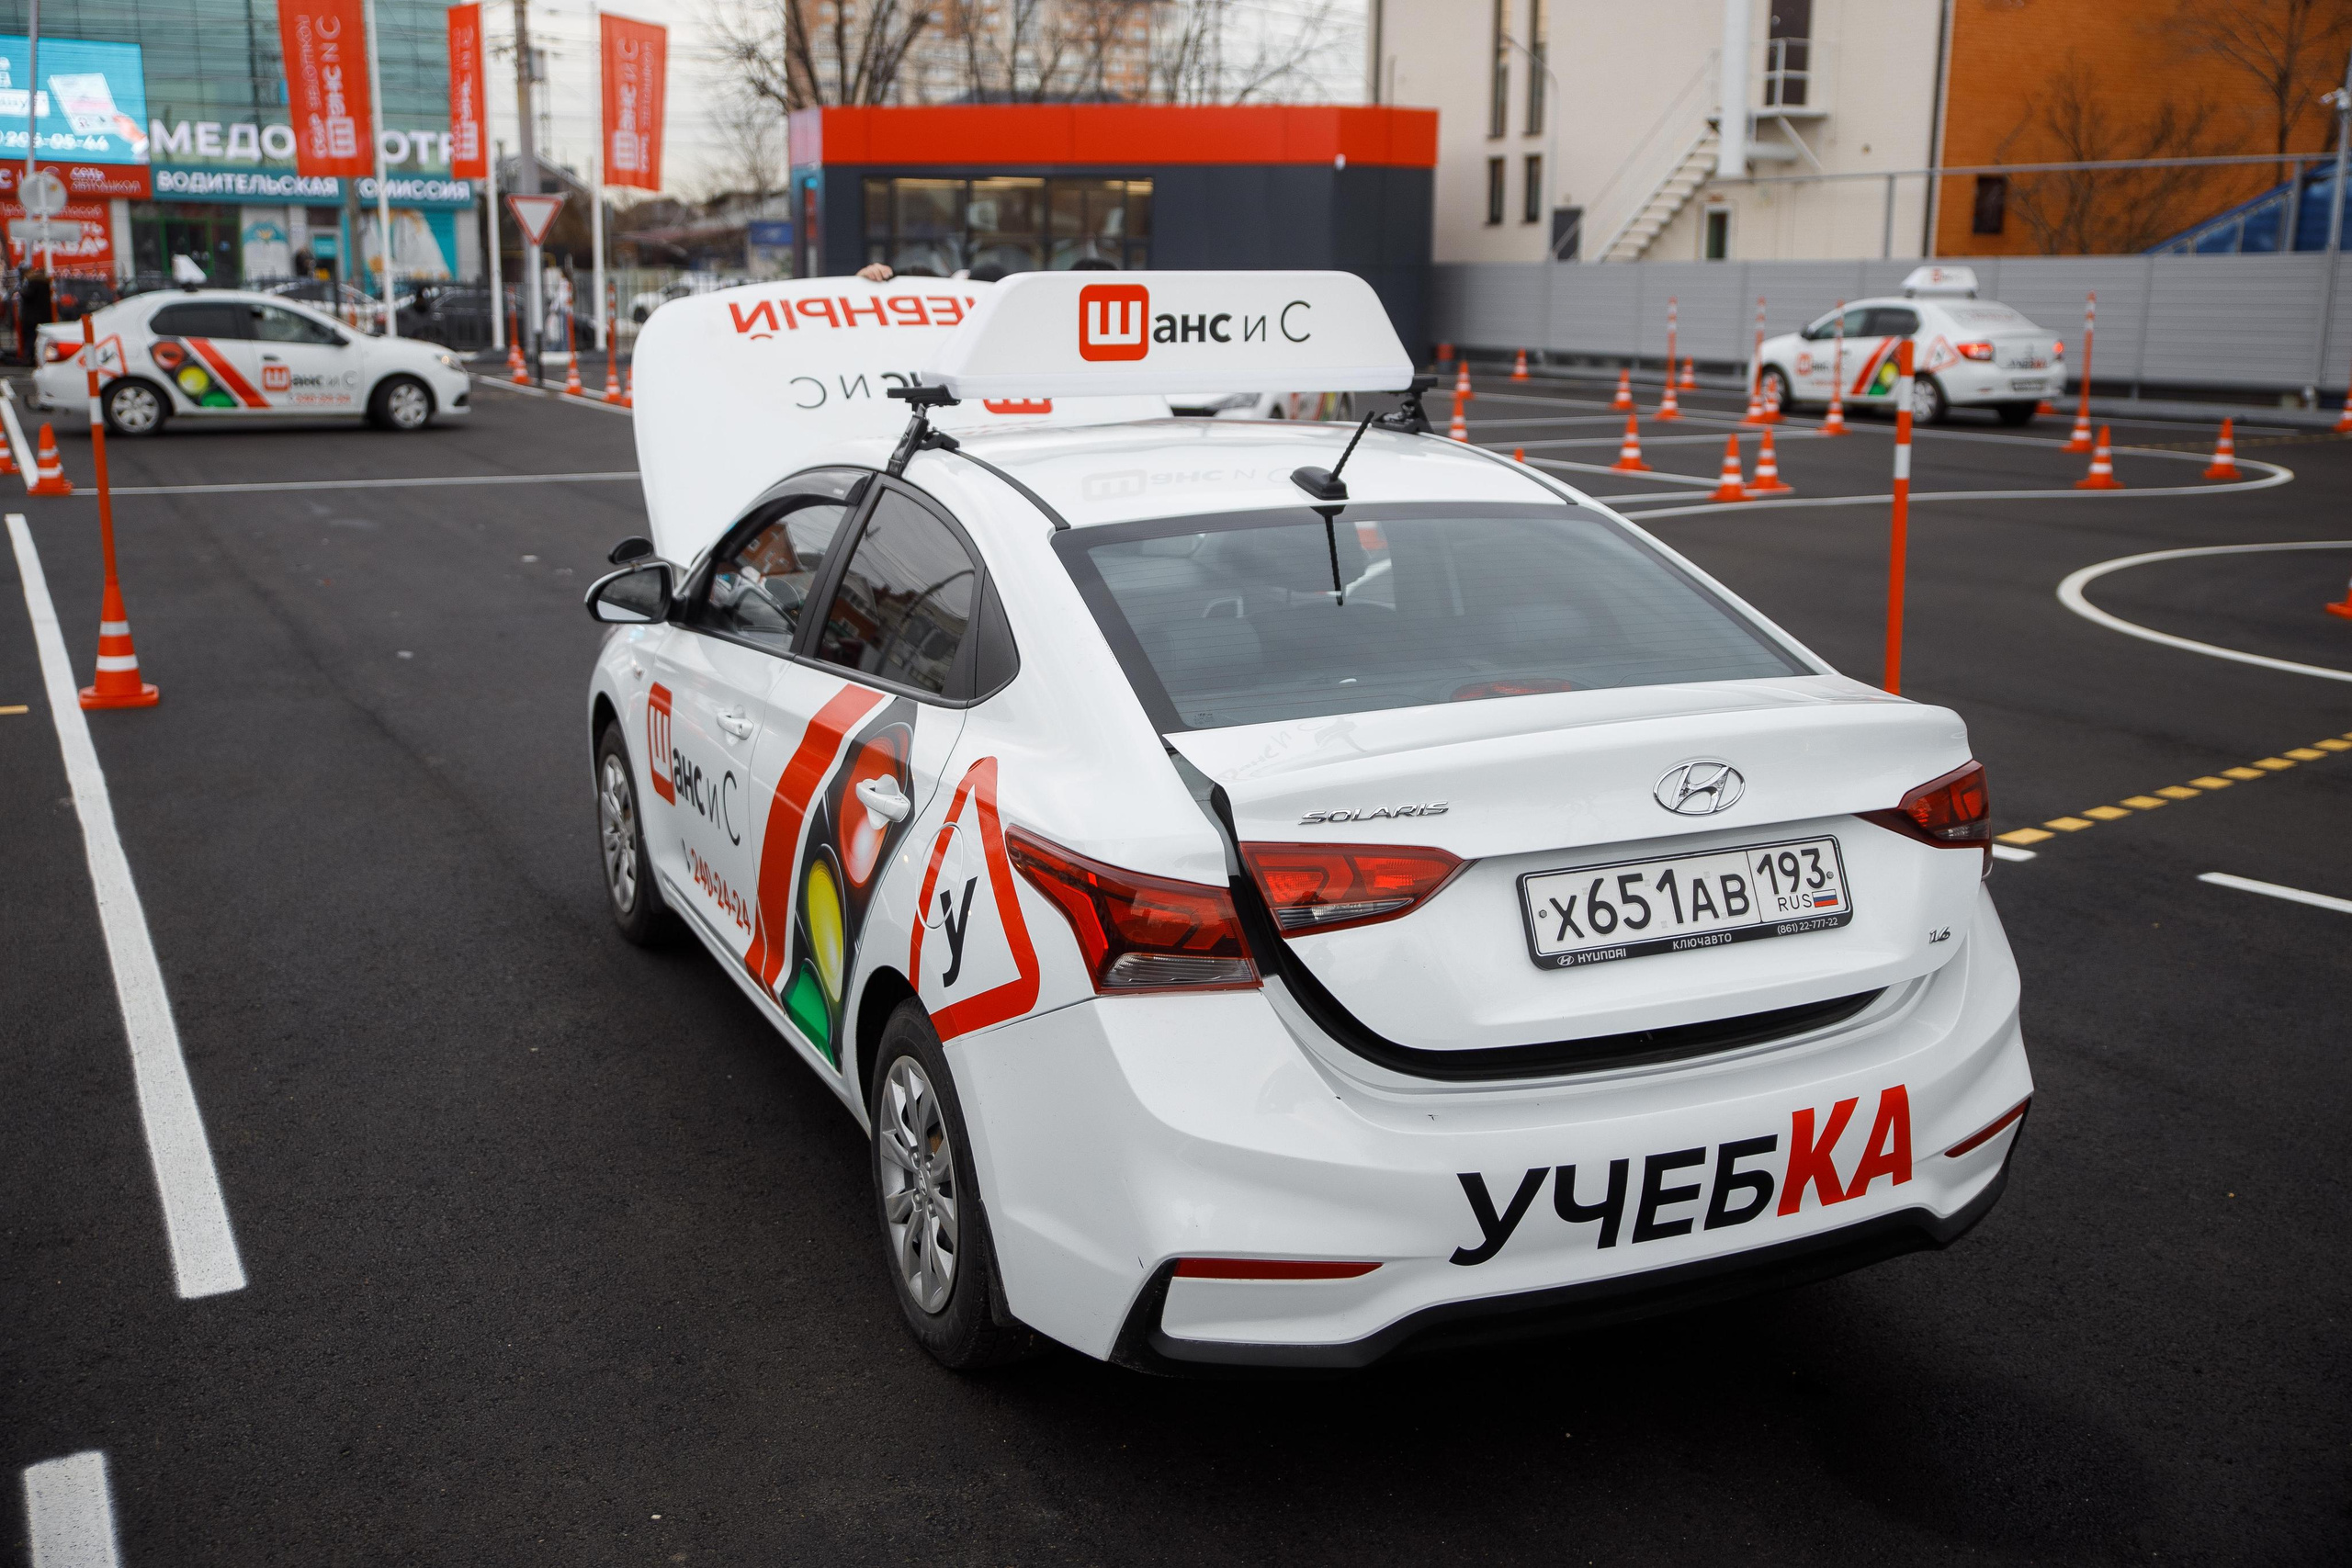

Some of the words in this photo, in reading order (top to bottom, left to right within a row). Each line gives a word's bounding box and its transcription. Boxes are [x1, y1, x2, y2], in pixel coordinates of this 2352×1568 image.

[157, 170, 339, 197] ВОДИТЕЛЬСКАЯ
[355, 176, 470, 201] ОМИССИЯ
[1081, 290, 1232, 355] Шанс
[1244, 314, 1266, 343] и
[1280, 299, 1312, 343] С
[648, 691, 706, 816] Шанс
[707, 776, 721, 830] и
[723, 770, 741, 846] С
[1297, 801, 1450, 826] SOLARIS
[691, 848, 752, 936] 240-24-24
[1756, 849, 1826, 896] 193
[1778, 894, 1812, 913] RUS
[1777, 922, 1799, 936] (861)
[1800, 917, 1838, 931] 22-777-22
[1577, 948, 1626, 964] HYUNDAI
[1449, 1084, 1913, 1267] УЧЕБКА
